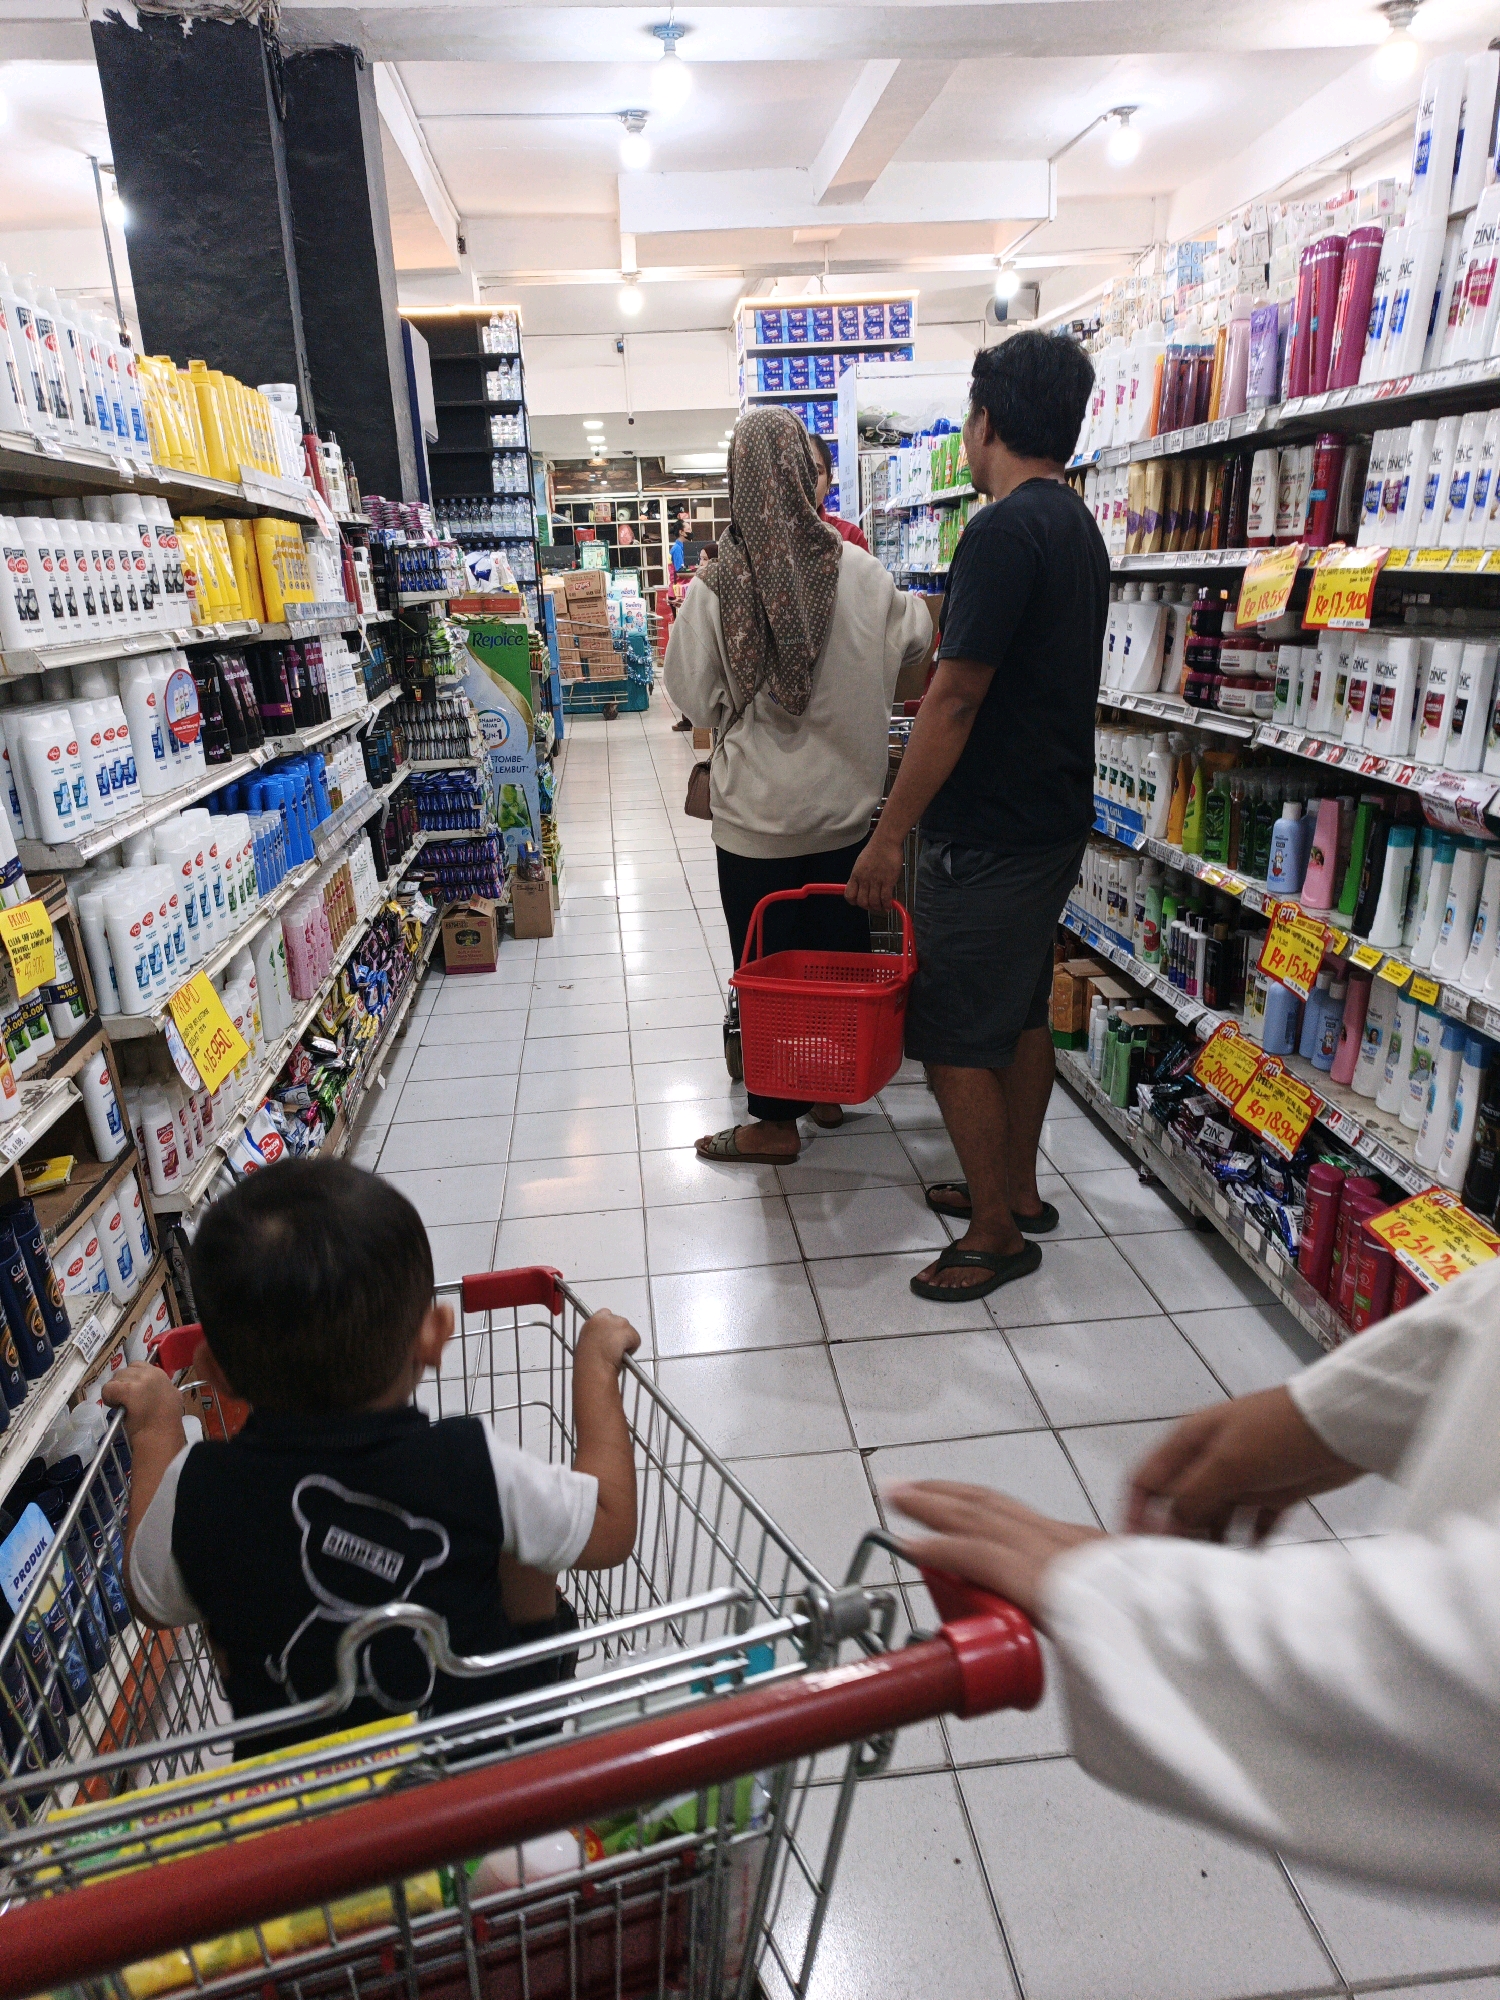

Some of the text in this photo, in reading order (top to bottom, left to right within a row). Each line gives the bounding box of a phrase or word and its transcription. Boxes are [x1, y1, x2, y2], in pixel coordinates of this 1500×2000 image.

[472, 632, 524, 649] Rejoice
[1203, 1123, 1225, 1142] ZINC
[13, 1536, 48, 1590] PRODUK
